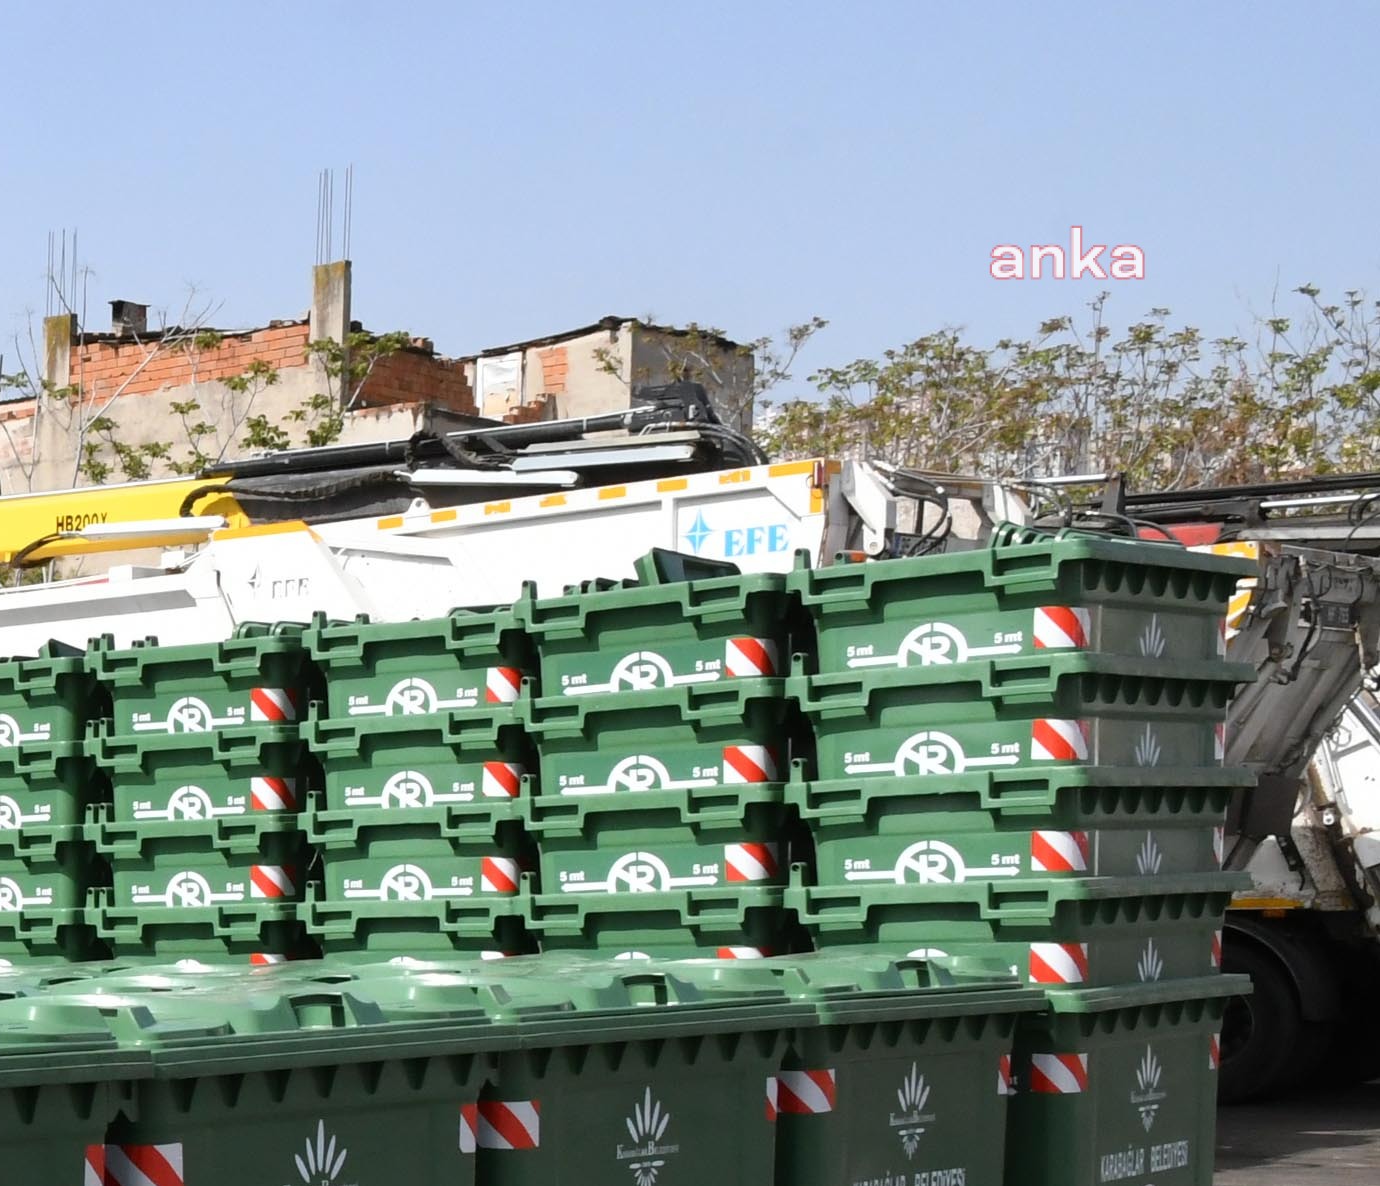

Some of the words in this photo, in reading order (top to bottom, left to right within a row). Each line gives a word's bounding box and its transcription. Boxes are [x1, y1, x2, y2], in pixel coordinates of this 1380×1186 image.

[724, 524, 789, 557] EFE
[993, 631, 1003, 645] 5
[1004, 630, 1023, 643] mt
[846, 645, 855, 658] 5
[856, 644, 874, 657] mt
[695, 660, 703, 672] 5
[705, 658, 722, 671] mt
[561, 674, 569, 687] 5
[571, 673, 588, 685] mt
[455, 687, 463, 699] 5
[464, 687, 479, 698] mt
[348, 695, 355, 707] 5
[356, 695, 369, 706] mt
[990, 742, 999, 755] 5
[1001, 742, 1020, 754] mt
[844, 752, 852, 764] 5
[853, 751, 871, 763] mt
[692, 766, 701, 779] 5
[702, 766, 719, 778] mt
[452, 782, 459, 793] 5
[460, 781, 475, 792] mt
[559, 775, 567, 787] 5
[569, 774, 585, 786] mt
[344, 786, 351, 797] 5
[352, 786, 365, 797] mt
[844, 858, 852, 871] 5
[853, 858, 871, 870] mt
[990, 853, 1000, 866] 5
[1002, 853, 1021, 865] mt
[559, 870, 567, 882] 5
[569, 870, 586, 882] mt
[692, 863, 701, 876] 5
[702, 863, 719, 875] mt
[343, 878, 349, 890] 5
[350, 879, 363, 889] mt
[451, 876, 458, 887] 5
[459, 876, 474, 887] mt
